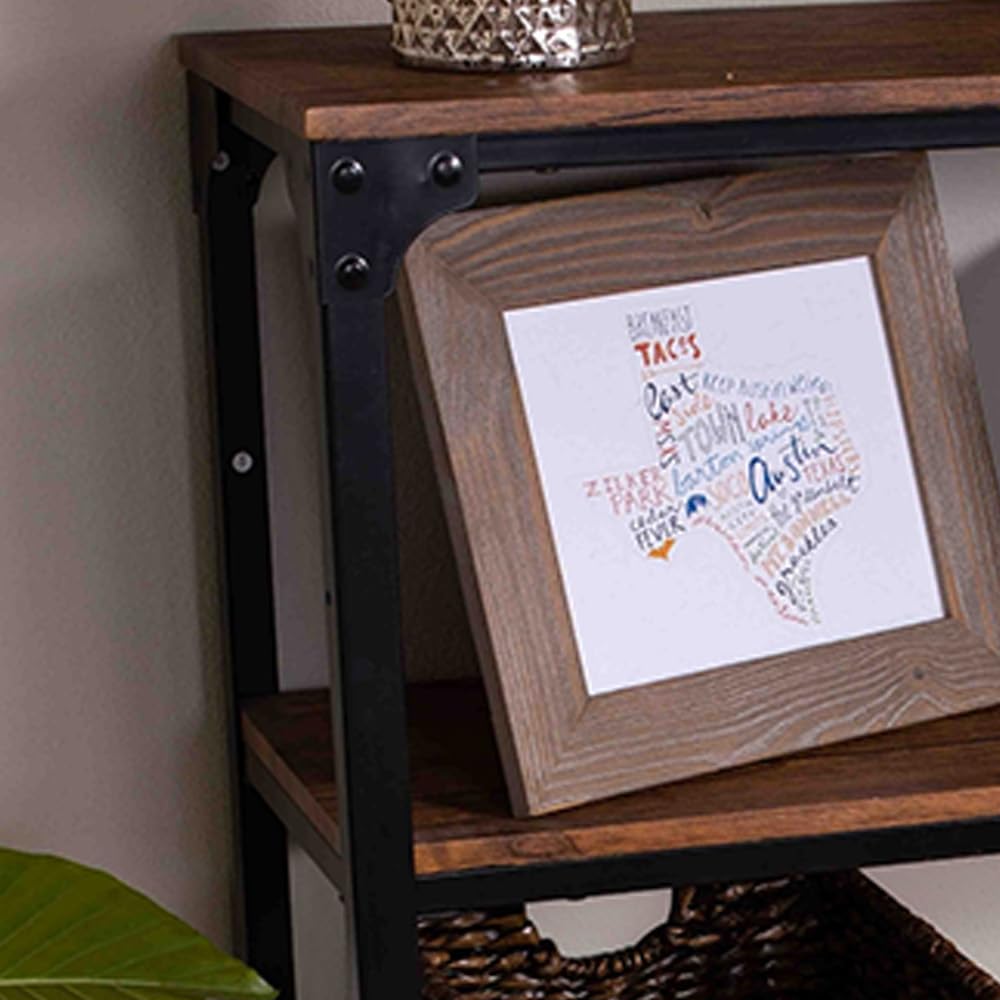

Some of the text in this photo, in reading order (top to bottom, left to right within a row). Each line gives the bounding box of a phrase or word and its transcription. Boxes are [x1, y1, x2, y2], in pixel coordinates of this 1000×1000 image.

[633, 333, 701, 367] TACOS
[676, 402, 746, 462] TOWN
[748, 434, 838, 504] Austin
